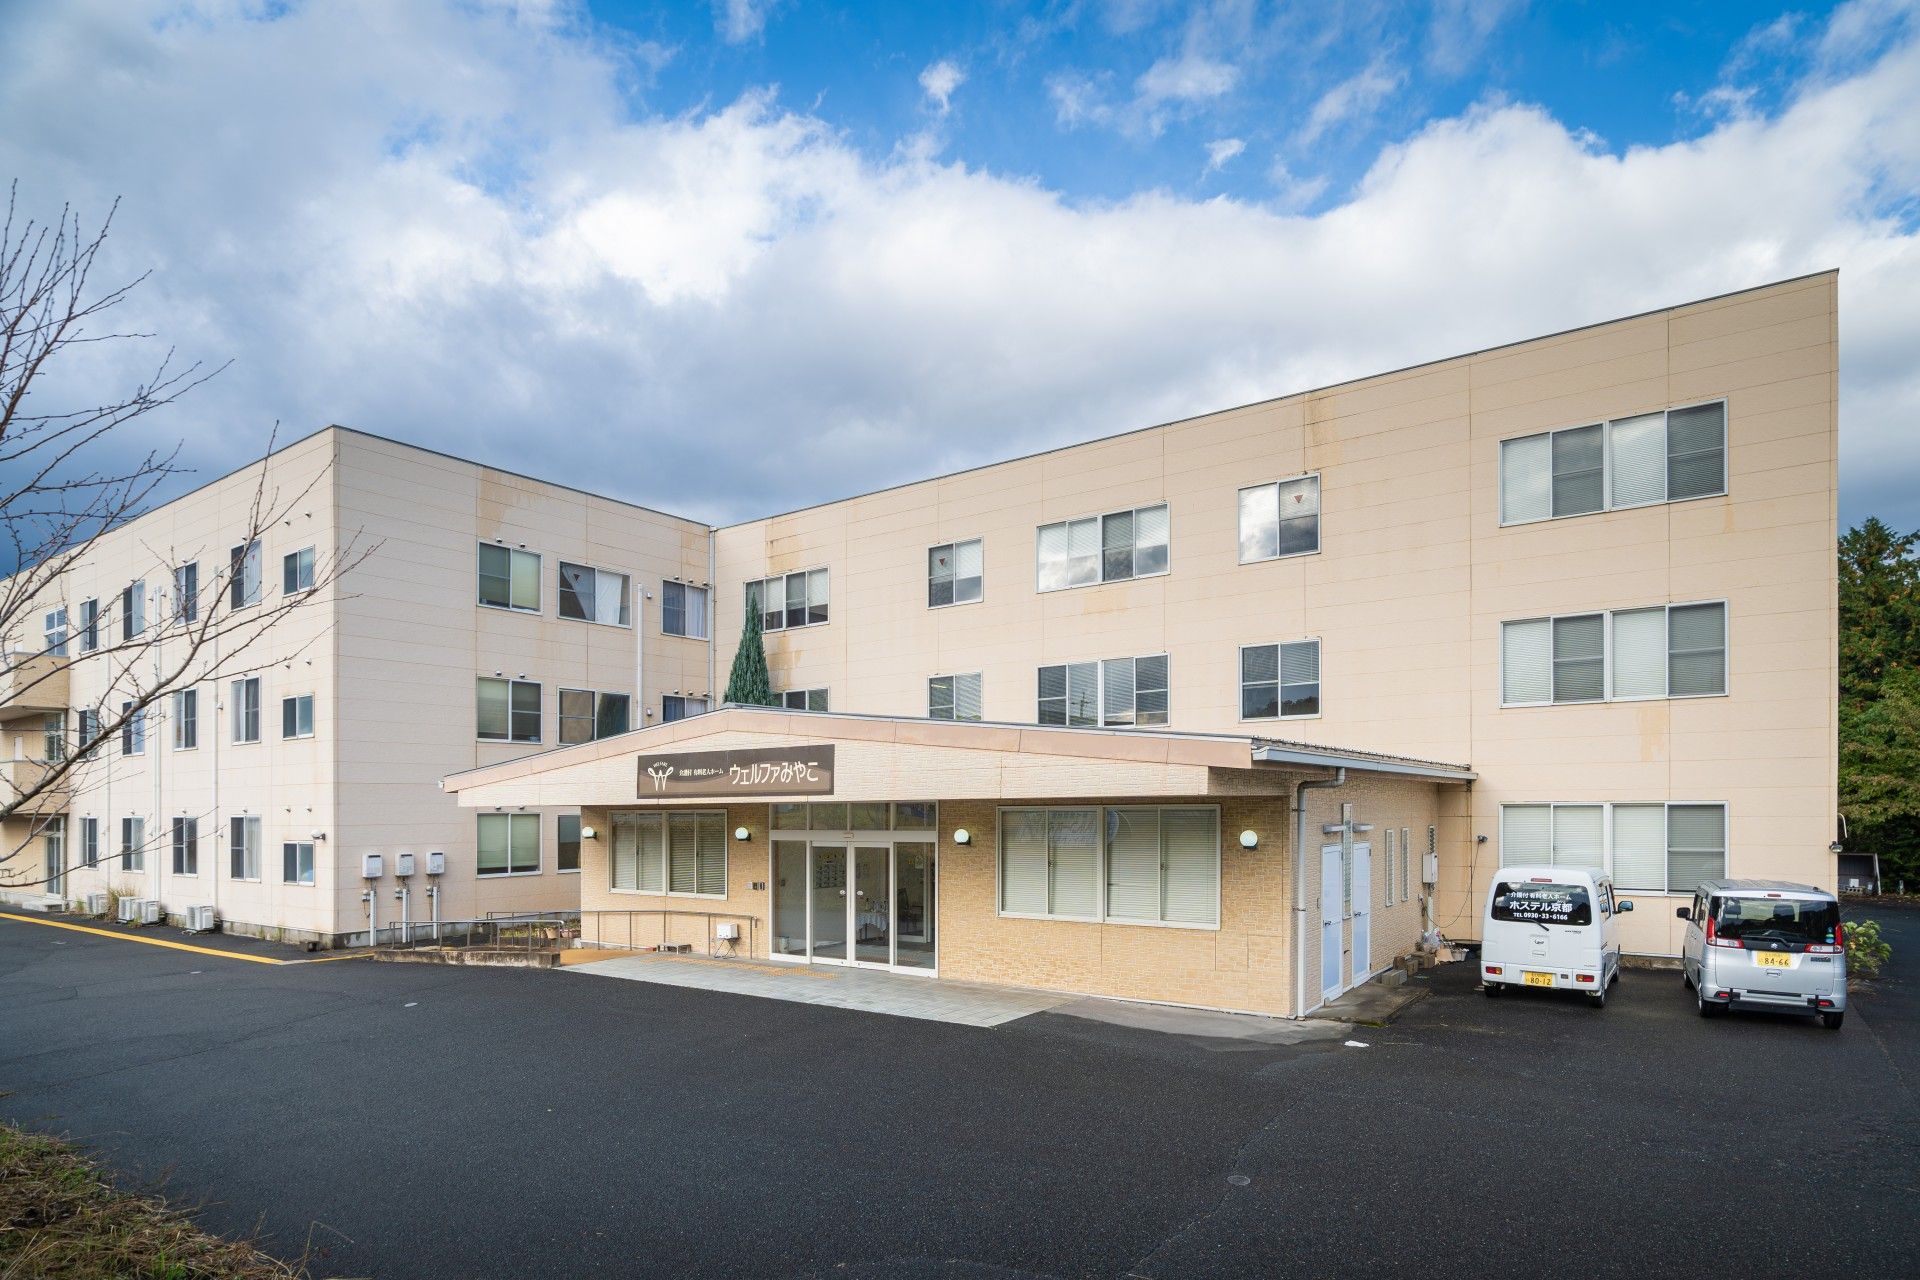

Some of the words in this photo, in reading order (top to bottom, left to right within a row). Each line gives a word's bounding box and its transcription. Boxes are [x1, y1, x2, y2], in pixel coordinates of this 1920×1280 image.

[729, 761, 818, 785] ウェルファみやこ
[1509, 901, 1572, 912] ホステル京都
